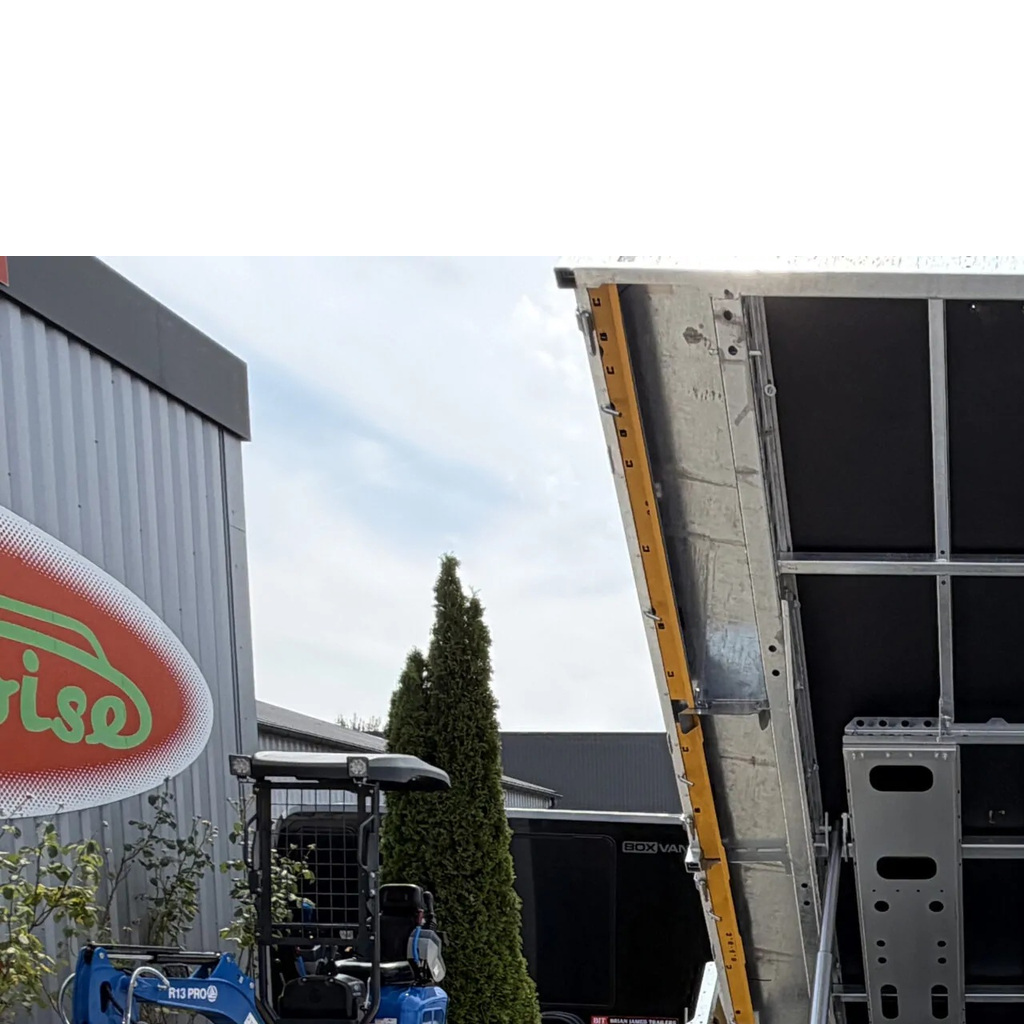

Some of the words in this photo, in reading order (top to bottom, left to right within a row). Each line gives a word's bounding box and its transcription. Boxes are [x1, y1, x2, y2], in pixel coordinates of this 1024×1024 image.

[623, 841, 657, 853] BOX
[659, 844, 687, 854] VAN
[168, 986, 186, 999] R13
[187, 987, 207, 999] PRO
